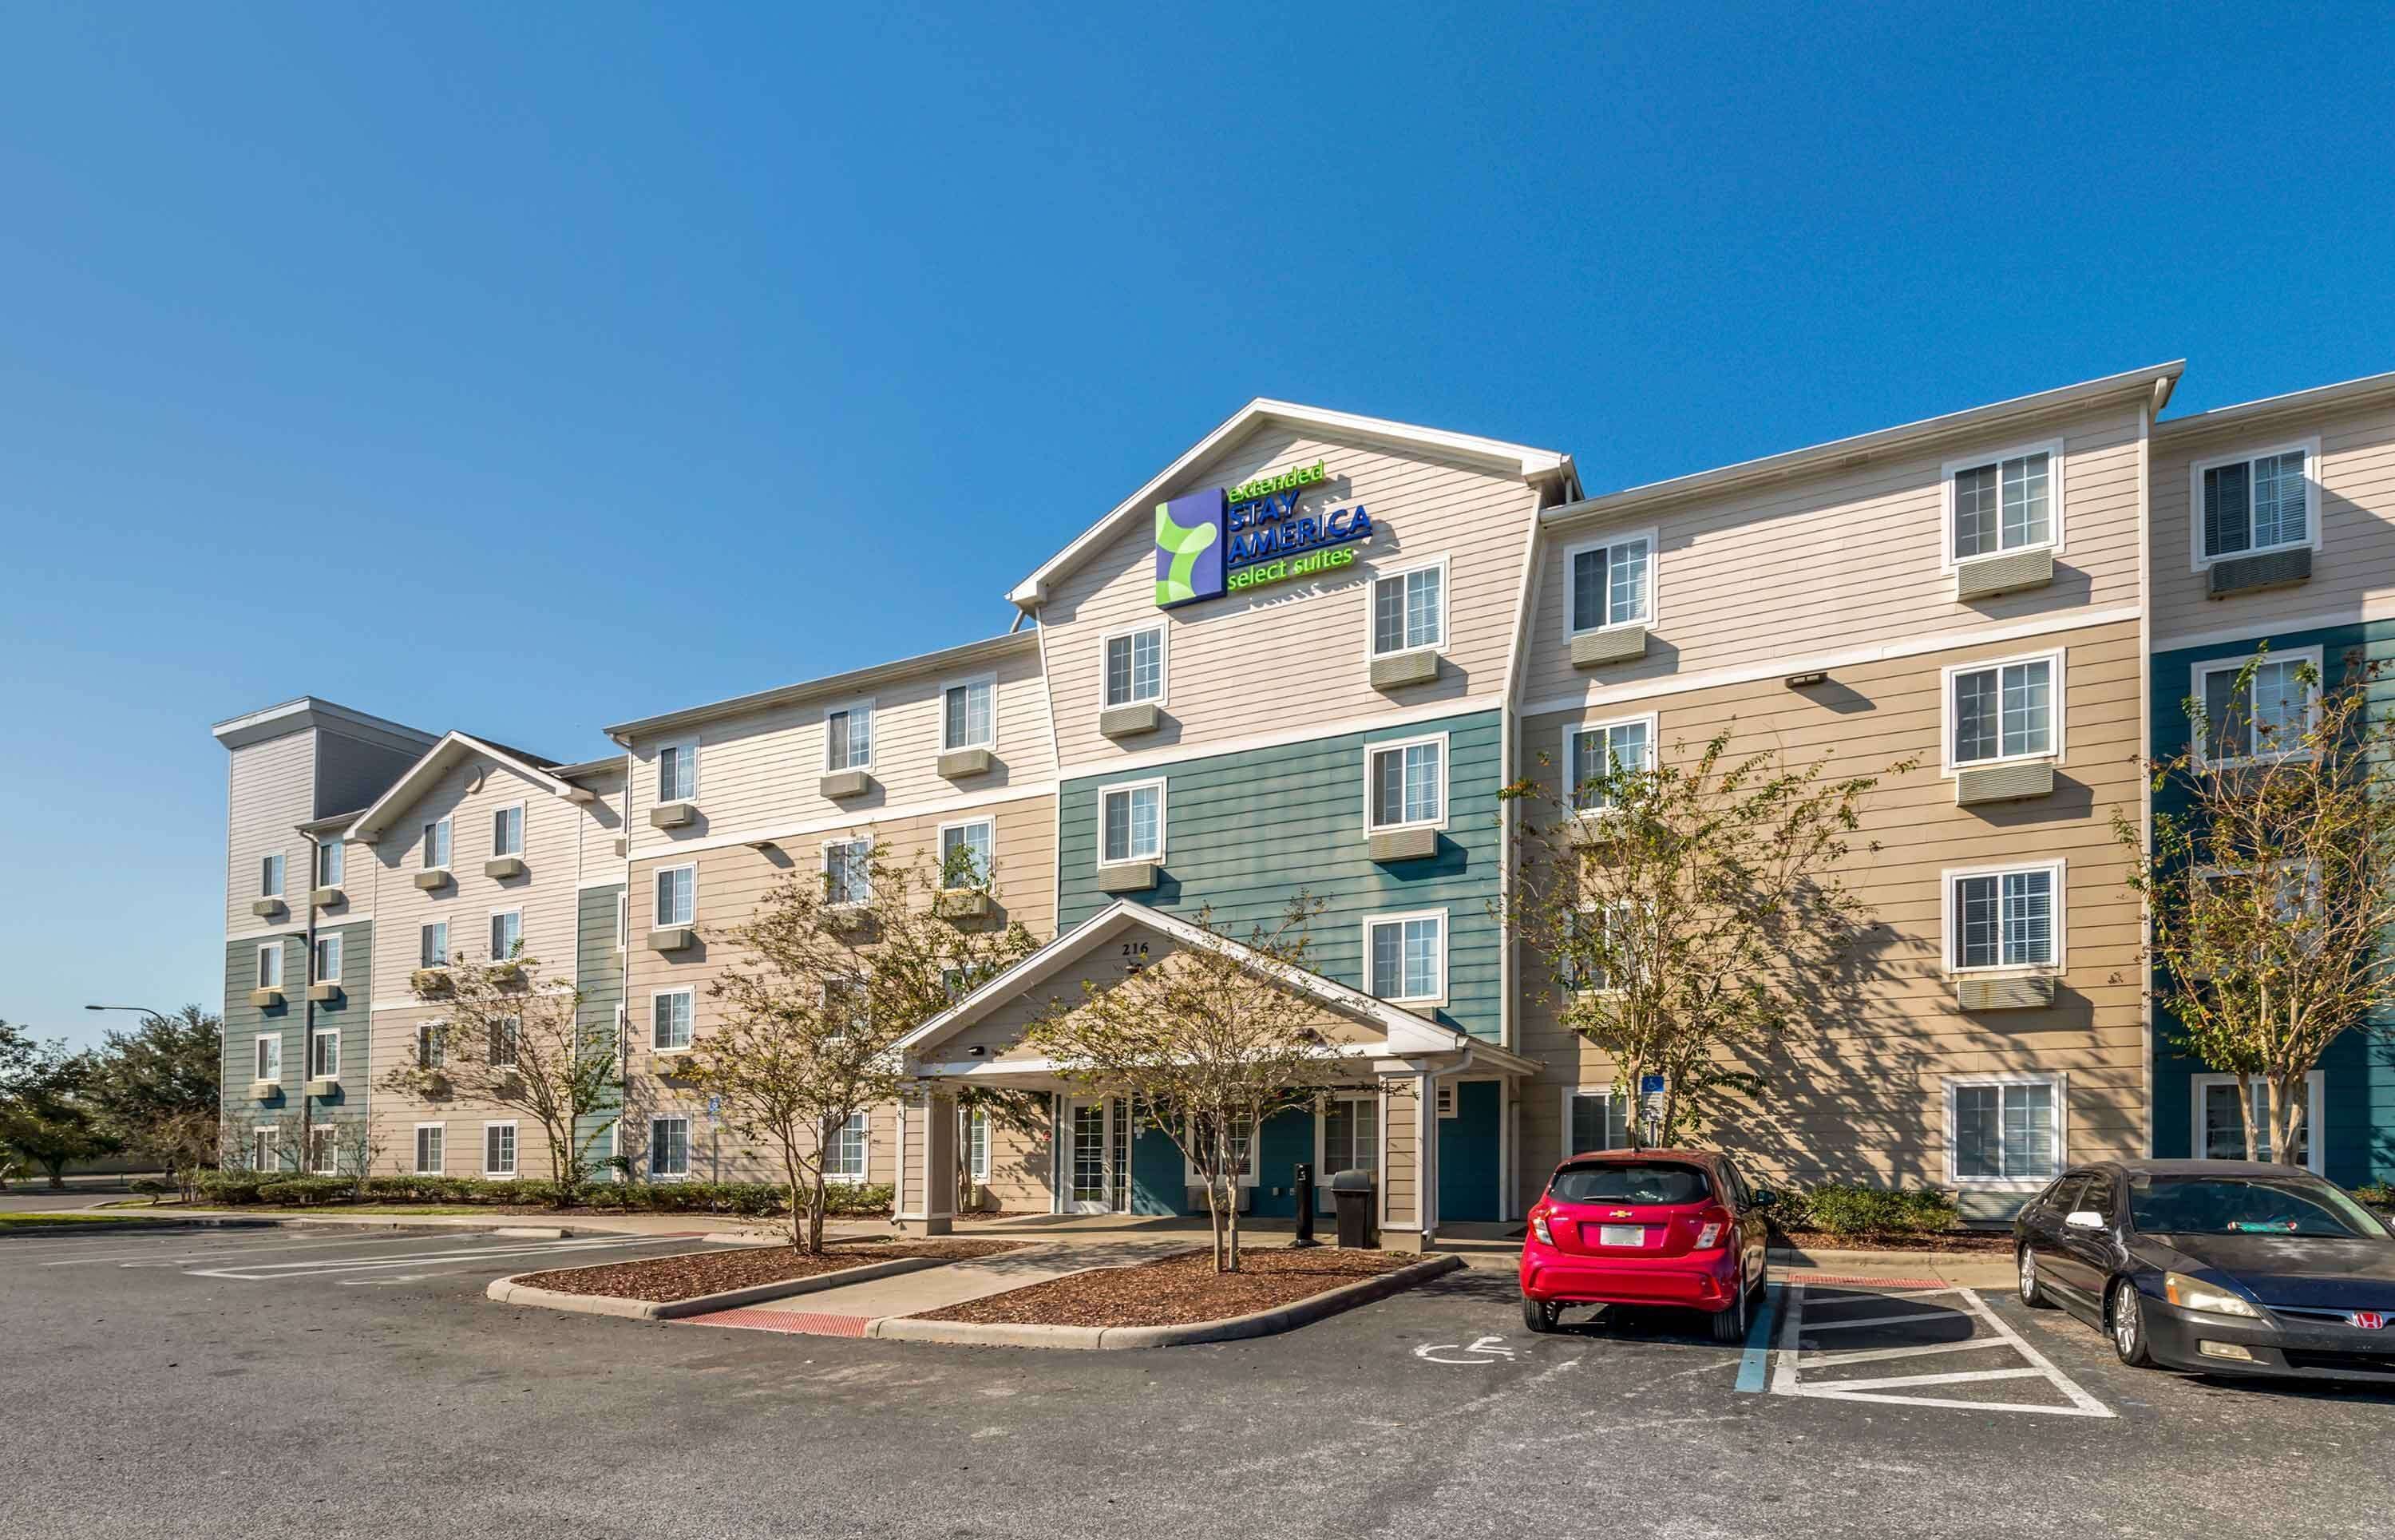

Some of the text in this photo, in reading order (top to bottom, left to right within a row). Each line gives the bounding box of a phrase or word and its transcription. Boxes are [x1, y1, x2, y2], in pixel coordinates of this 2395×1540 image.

[1229, 459, 1325, 503] extended
[1229, 489, 1300, 532] STAY
[1228, 505, 1372, 563] AMERICA
[1227, 547, 1354, 592] select suites
[1122, 942, 1148, 955] 216
